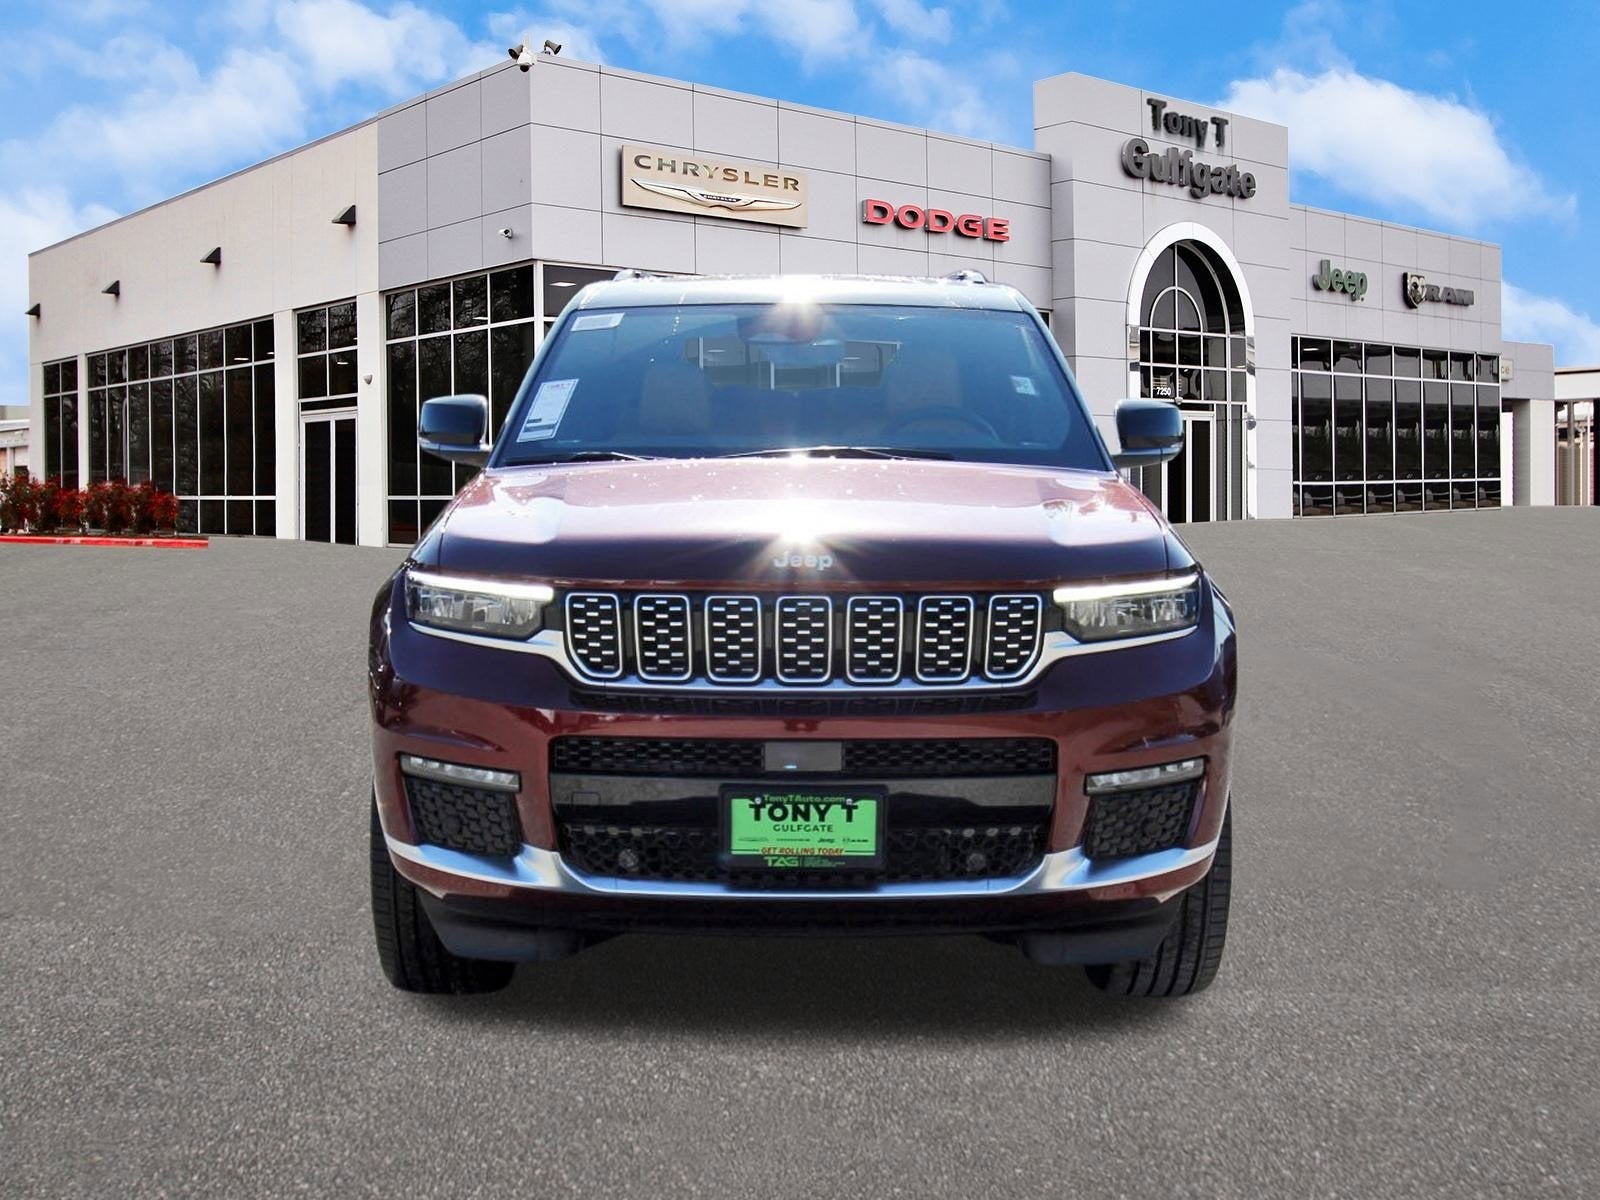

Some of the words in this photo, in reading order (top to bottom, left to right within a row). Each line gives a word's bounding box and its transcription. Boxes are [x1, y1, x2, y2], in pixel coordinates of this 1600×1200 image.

[1146, 98, 1208, 148] Tony
[1210, 116, 1229, 148] T
[633, 154, 801, 192] CHRYSLER
[1121, 138, 1257, 199] Gulfgate
[862, 198, 1011, 242] DODGE
[1312, 259, 1368, 301] Jeep
[1424, 284, 1475, 306] RAM
[1156, 386, 1172, 396] 7250
[773, 550, 834, 571] Jeep
[749, 802, 833, 822] TONY
[841, 804, 859, 822] T
[773, 824, 834, 833] GULFGATE
[761, 847, 777, 855] GET
[778, 848, 815, 856] ROLLING
[818, 848, 844, 856] TODAY
[763, 856, 799, 867] TAG
